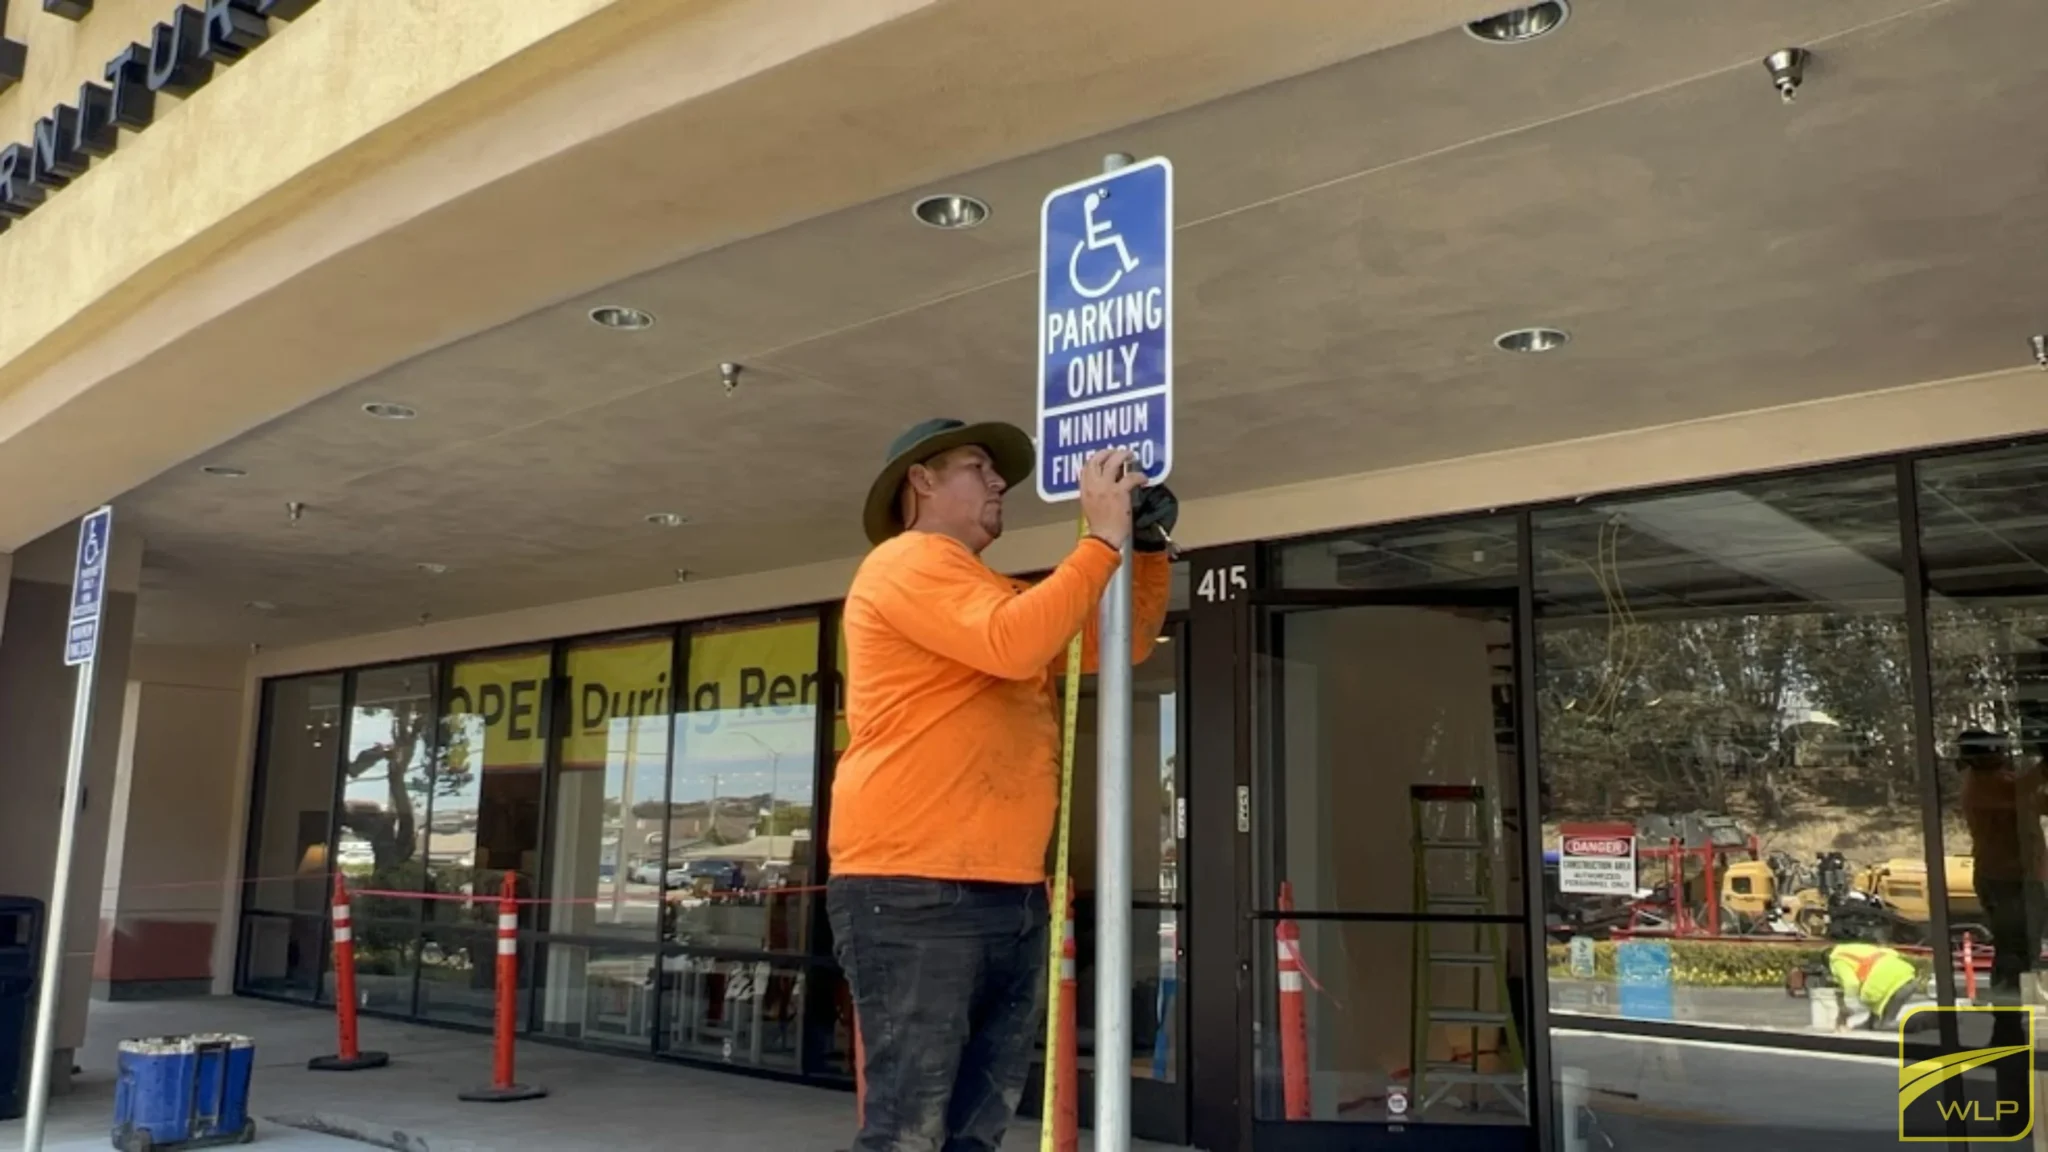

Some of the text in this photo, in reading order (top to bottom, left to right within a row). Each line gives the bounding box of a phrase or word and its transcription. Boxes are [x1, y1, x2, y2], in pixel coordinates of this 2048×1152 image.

[0, 0, 300, 214] RNITUR
[1047, 286, 1163, 355] PARKING
[1066, 342, 1140, 399] ONLY
[1058, 400, 1149, 448] MINIMUM
[1052, 438, 1154, 486] FIN 50
[1196, 564, 1248, 602] 415
[582, 671, 721, 735] Durig
[1572, 840, 1624, 854] DANGER
